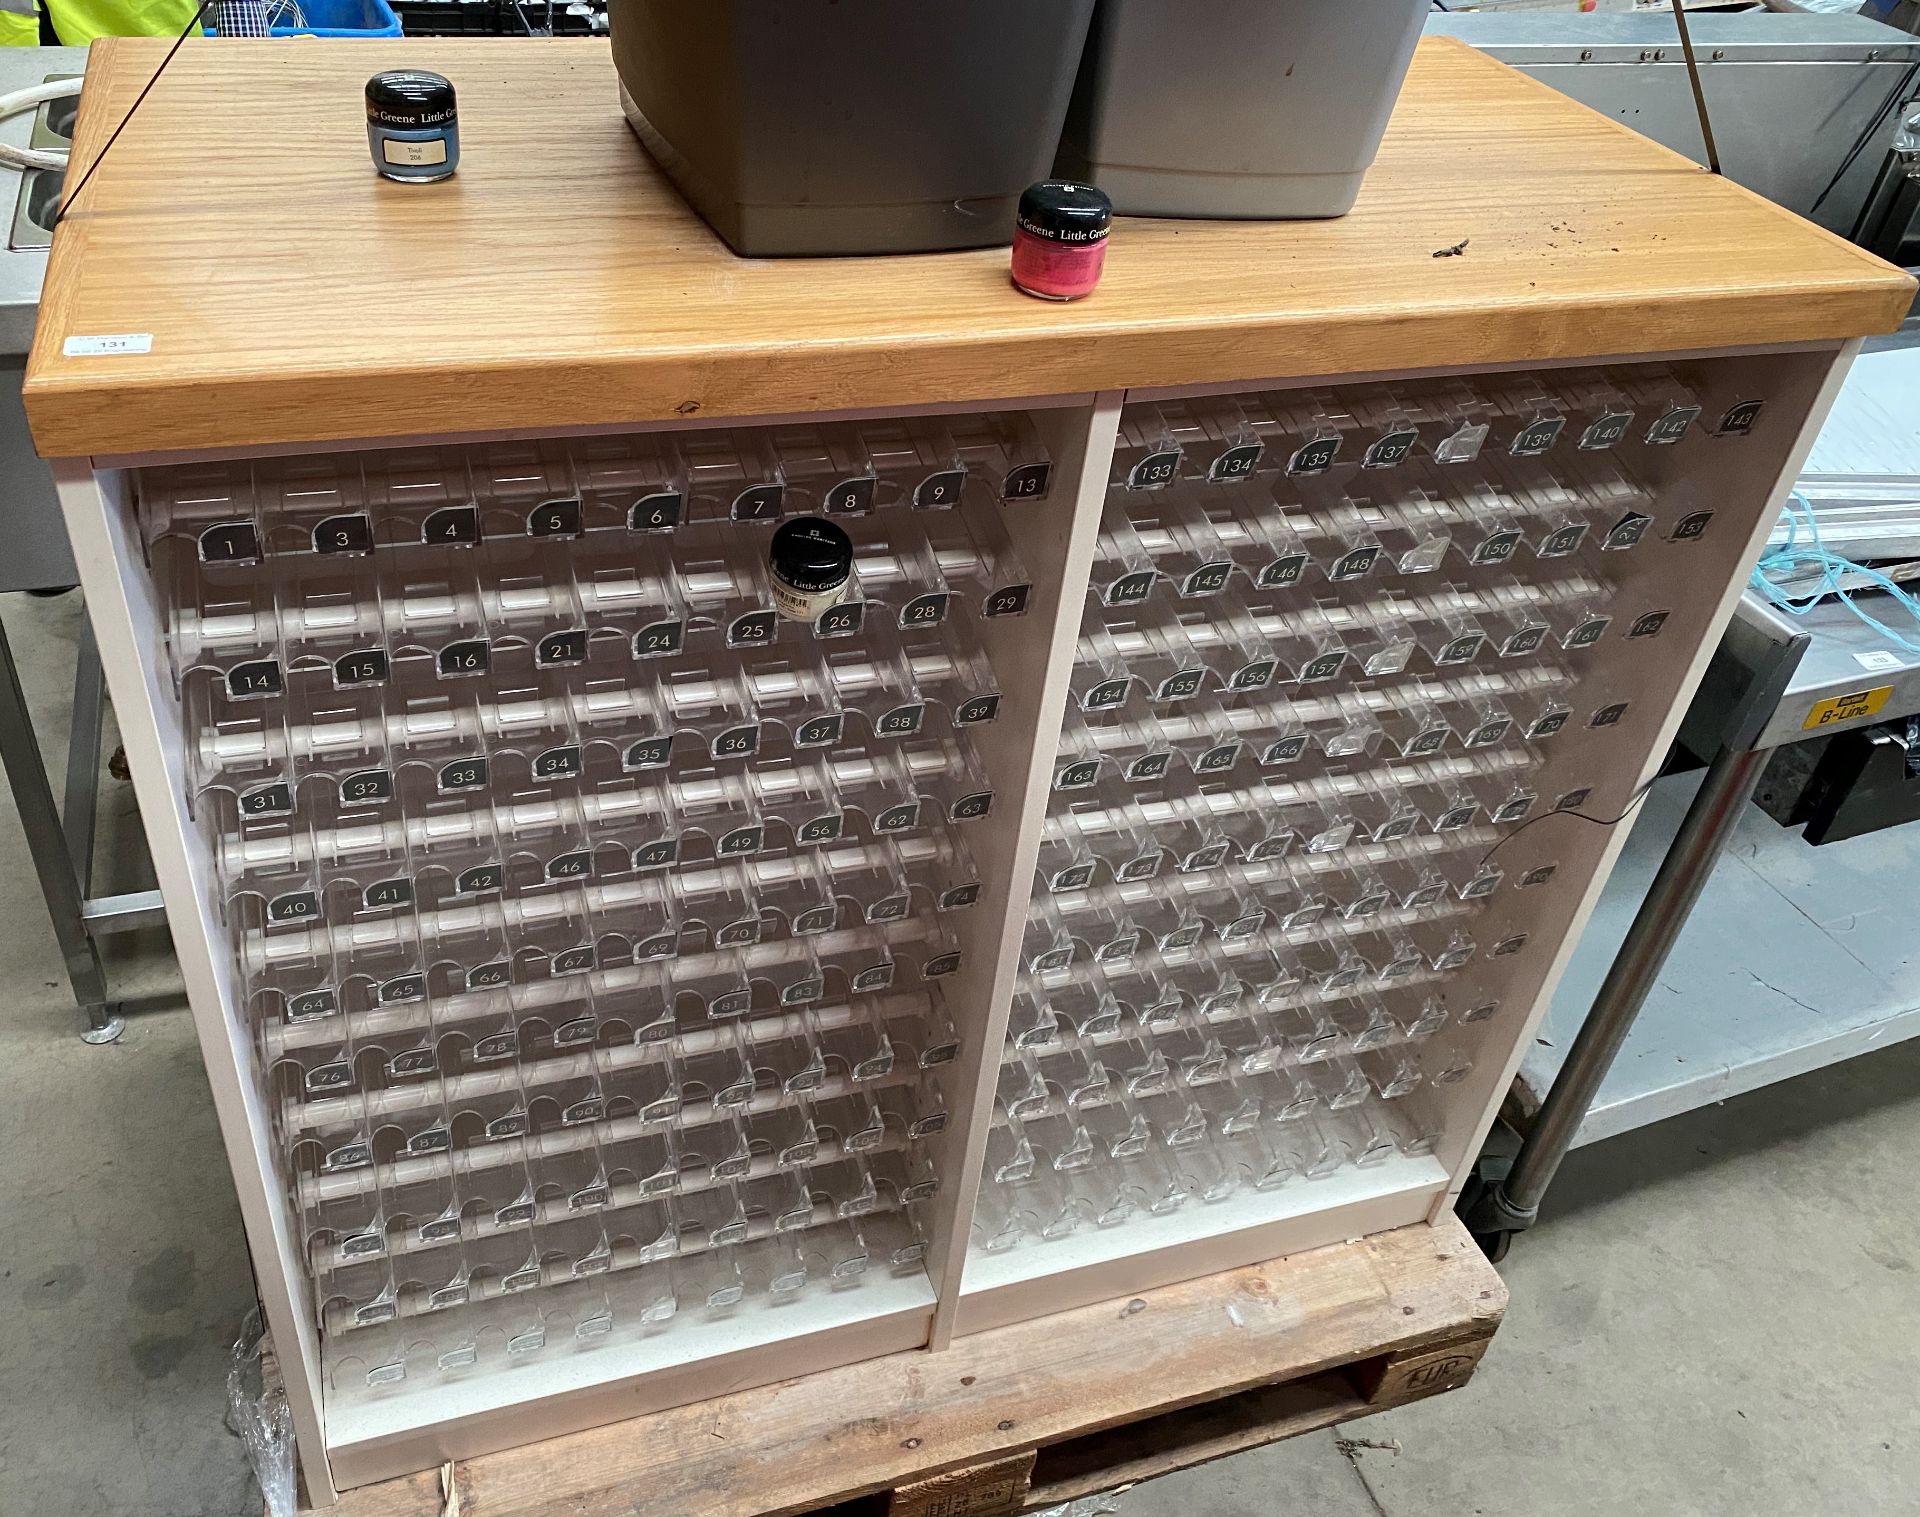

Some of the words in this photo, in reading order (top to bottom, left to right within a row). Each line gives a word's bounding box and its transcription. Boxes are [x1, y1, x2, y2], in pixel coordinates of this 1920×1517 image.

[380, 106, 416, 123] Greene
[421, 112, 445, 123] Little
[1024, 218, 1054, 238] Greene
[1060, 229, 1087, 241] Little
[99, 341, 127, 349] 131
[1662, 420, 1687, 433] 142
[1728, 413, 1751, 427] 143
[1594, 426, 1618, 440] 140
[1524, 433, 1550, 447] 139
[1300, 451, 1329, 465] 135
[1376, 445, 1406, 459] 137
[1142, 464, 1172, 479] 133
[1222, 459, 1251, 472] 134
[1016, 478, 1037, 494] 13
[934, 486, 945, 501] 9
[754, 500, 765, 515] 7
[844, 494, 857, 509] 8
[550, 515, 562, 530] 5
[650, 509, 663, 525] 6
[445, 524, 458, 538] 4
[1680, 522, 1704, 535] 153
[336, 532, 350, 547] 3
[1551, 536, 1575, 549] 151
[224, 539, 235, 556] 1
[1484, 543, 1511, 556] 150
[1342, 558, 1369, 572] 148
[1270, 566, 1296, 580] 146
[793, 579, 817, 590] Little
[1195, 574, 1222, 588] 145
[1118, 583, 1144, 597] 144
[996, 596, 1018, 610] 29
[914, 605, 936, 620] 28
[829, 613, 851, 629] 26
[1636, 621, 1659, 633] 162
[742, 625, 765, 638] 25
[1576, 630, 1599, 642] 161
[648, 634, 671, 649] 24
[1513, 636, 1537, 649] 160
[550, 644, 572, 658] 21
[1448, 644, 1474, 658] 159
[454, 654, 477, 668] 16
[350, 663, 375, 678] 15
[1309, 663, 1336, 675] 157
[244, 674, 269, 690] 14
[1240, 671, 1266, 684] 156
[1168, 680, 1195, 693] 155
[1095, 688, 1121, 701] 154
[968, 706, 989, 720] 39
[1819, 705, 1869, 724] B-Line
[890, 716, 911, 729] 38
[1538, 719, 1560, 731] 170
[810, 727, 831, 740] 37
[1479, 728, 1501, 740] 169
[725, 737, 747, 751] 36
[1274, 744, 1298, 756] 166
[638, 747, 661, 761] 35
[1206, 755, 1230, 766] 165
[546, 757, 569, 771] 34
[1138, 763, 1161, 774] 164
[452, 770, 476, 784] 33
[1067, 770, 1092, 782] 163
[354, 781, 379, 796] 32
[254, 795, 277, 809] 31
[964, 802, 981, 816] 63
[888, 815, 907, 827] 62
[810, 824, 830, 837] 56
[730, 837, 752, 849] 49
[646, 850, 666, 862] 47
[558, 862, 580, 873] 46
[470, 876, 493, 887] 42
[1062, 873, 1086, 884] 172
[378, 889, 399, 901] 41
[952, 892, 970, 904] 74
[282, 902, 306, 915] 40
[880, 905, 899, 917] 72
[806, 916, 824, 928] 71
[729, 928, 750, 940] 70
[648, 942, 668, 955] 69
[564, 956, 585, 968] 67
[479, 972, 501, 983] 66
[392, 985, 415, 996] 65
[302, 999, 324, 1011] 64
[721, 1000, 738, 1012] 81
[568, 1027, 588, 1038] 79
[648, 1028, 669, 1039] 80
[487, 1042, 508, 1054] 78
[404, 1057, 424, 1068] 77
[318, 1072, 341, 1083] 76
[575, 1107, 594, 1118] 90
[418, 1137, 440, 1147] 87
